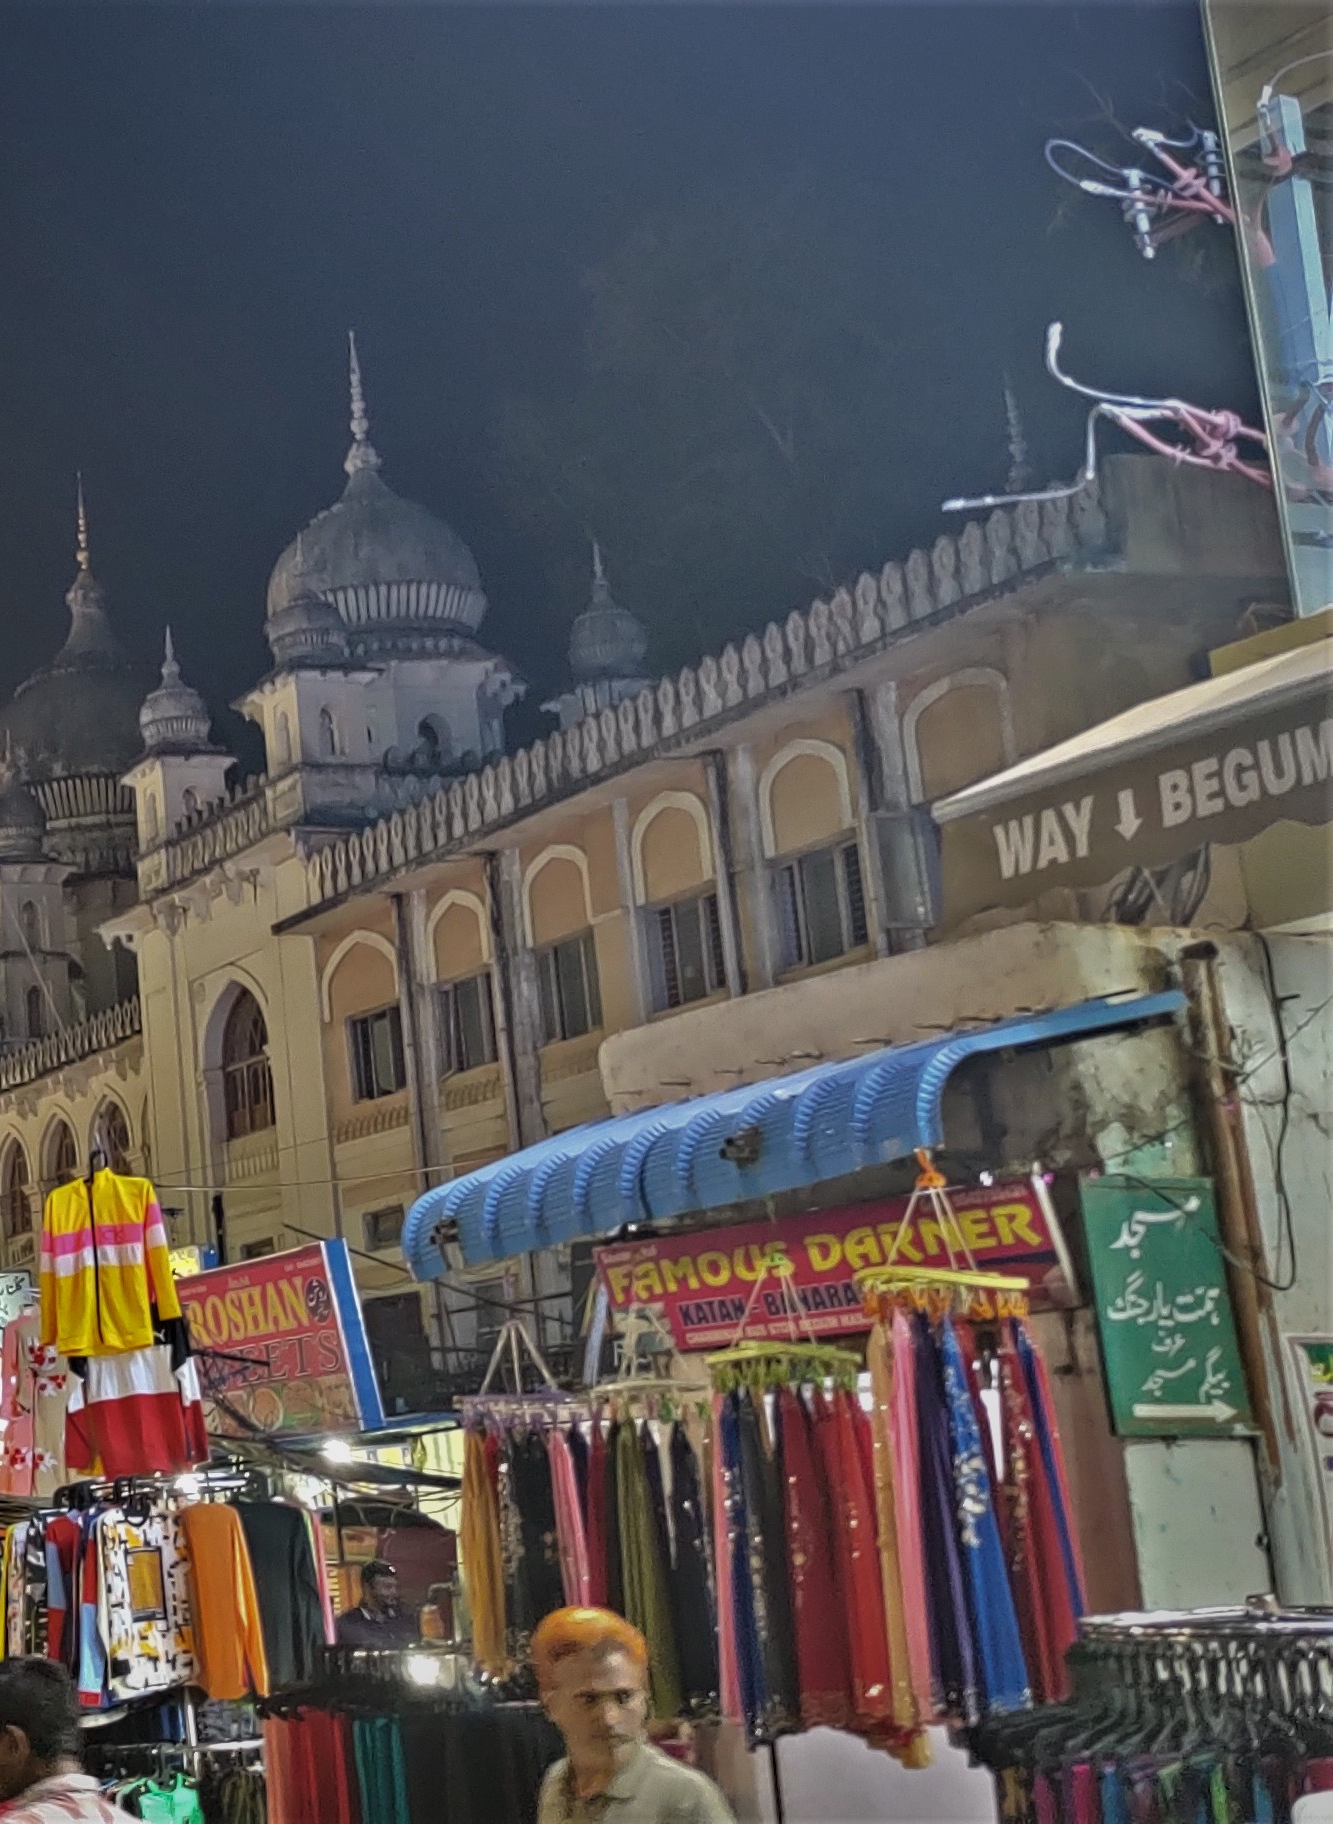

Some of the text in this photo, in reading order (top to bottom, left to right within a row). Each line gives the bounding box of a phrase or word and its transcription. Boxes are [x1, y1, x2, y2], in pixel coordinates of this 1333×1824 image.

[992, 719, 1333, 880] WAY BEGUM
[606, 1203, 1043, 1305] FAMOUS DARNER
[1109, 1195, 1202, 1260] مسجد
[186, 1275, 311, 1348] ROSHAN
